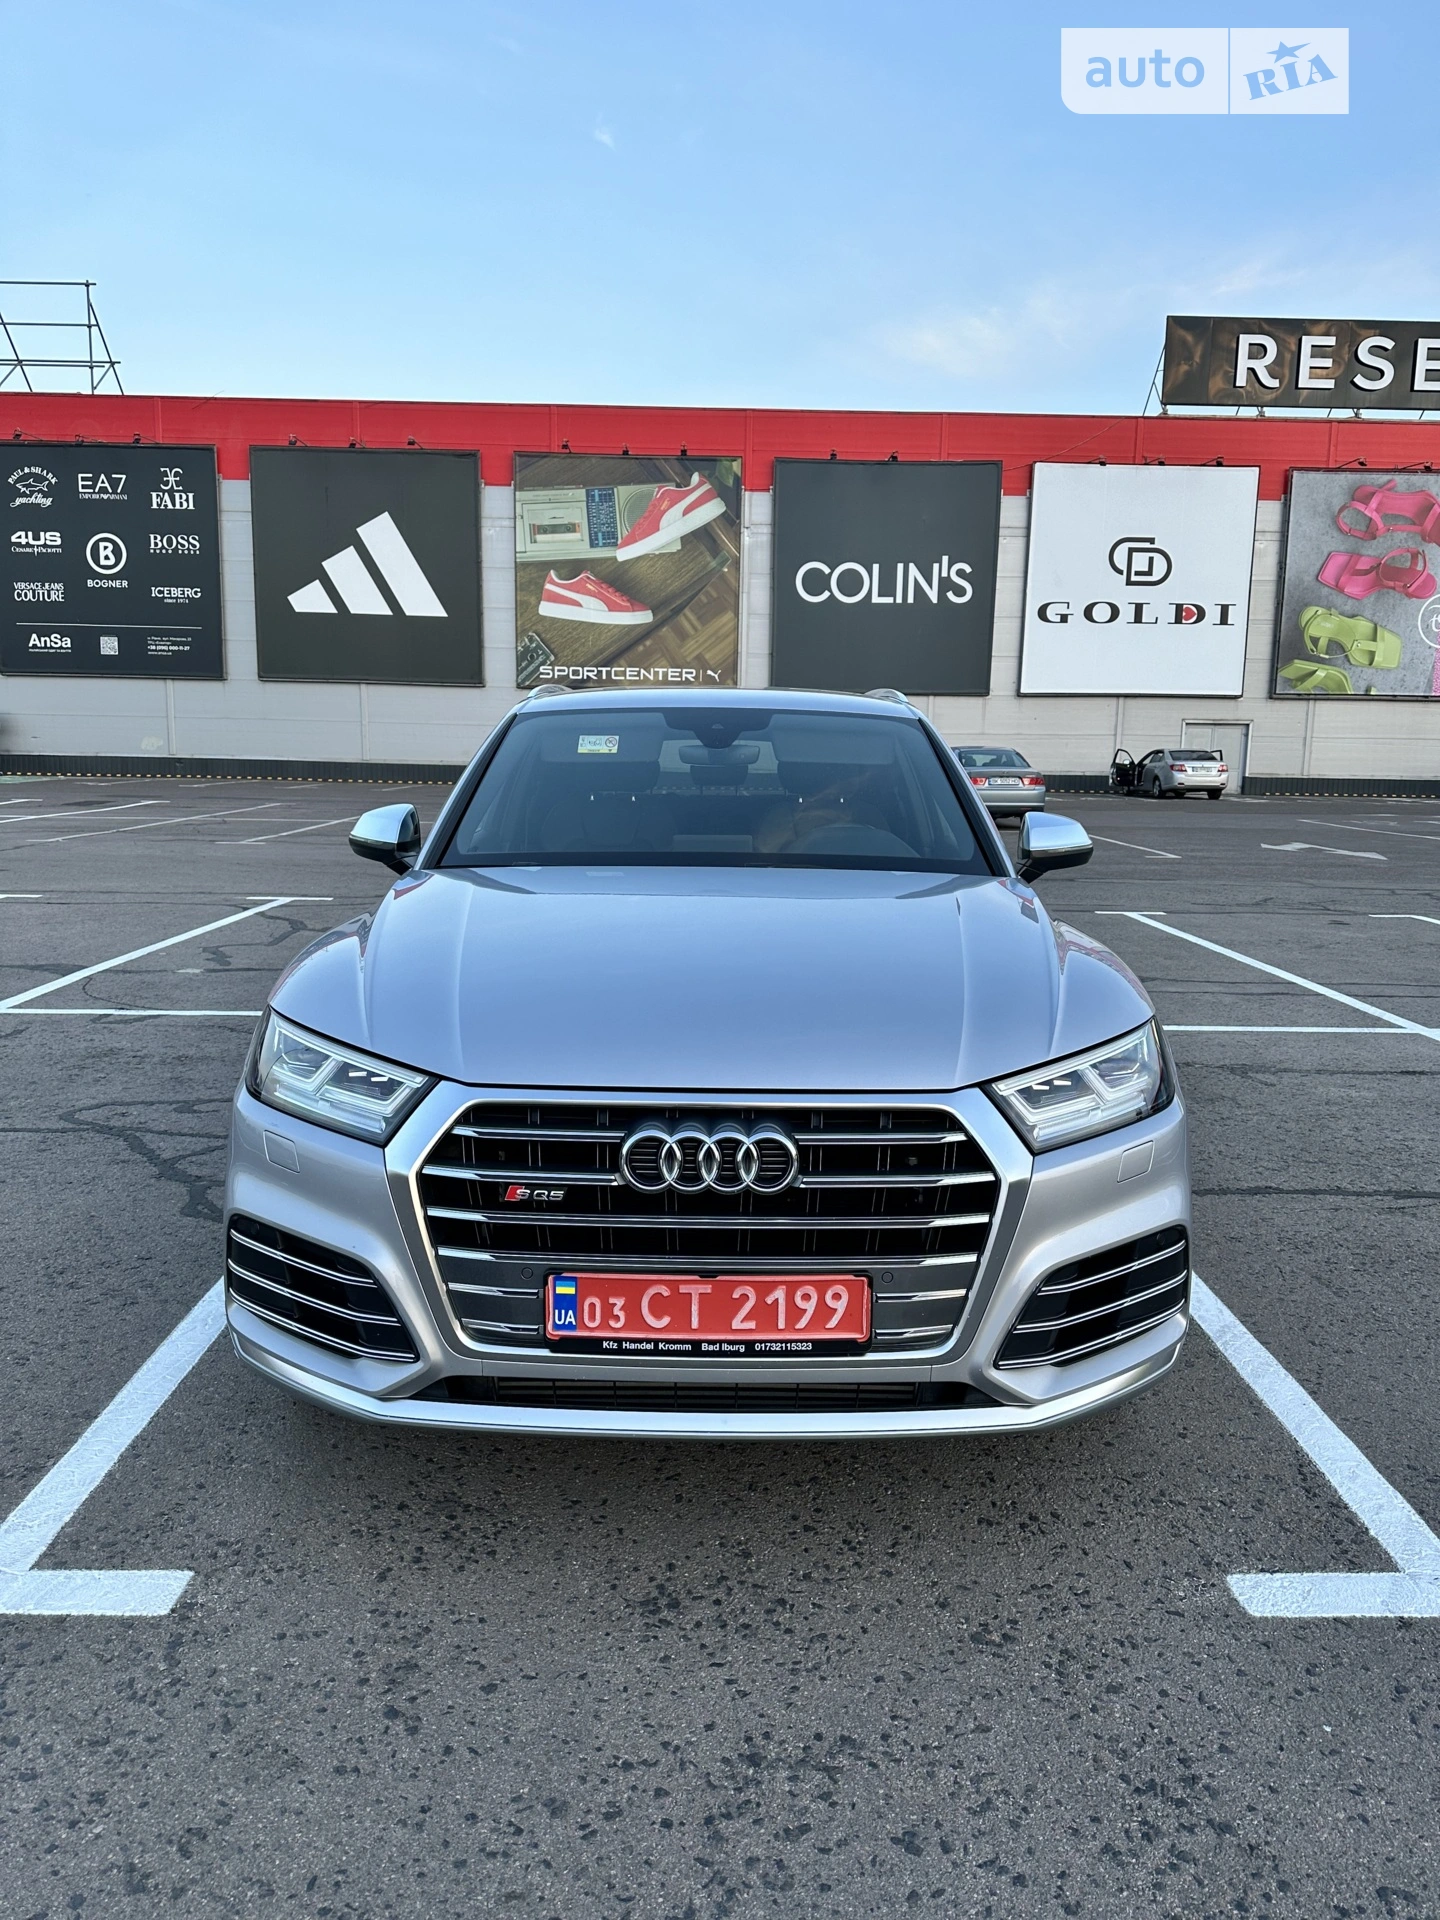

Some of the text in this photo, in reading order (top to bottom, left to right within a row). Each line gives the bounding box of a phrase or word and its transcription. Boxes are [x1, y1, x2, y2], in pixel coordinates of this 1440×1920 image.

[1235, 333, 1440, 391] RESE
[7, 469, 24, 484] PAUL
[30, 466, 58, 485] SHARK
[78, 473, 127, 493] EA7
[10, 492, 53, 507] yachting
[150, 491, 195, 510] FABI
[11, 531, 62, 545] 4US
[149, 534, 200, 550] BOSS
[13, 582, 64, 591] VERSACE JEANS
[87, 579, 128, 588] BOGNER
[795, 555, 973, 604] COLIN'S
[14, 590, 65, 602] COUTURE
[151, 587, 201, 598] ICEBERG
[1037, 601, 1236, 626] GOLDI
[28, 633, 72, 648] AnSa
[539, 666, 696, 682] SPORTCENTER
[582, 1284, 849, 1330] 03 CT 2199
[554, 1309, 576, 1326] UA
[602, 1341, 813, 1352] Kfz Handel Kromm Bad Iburg 01732115323
